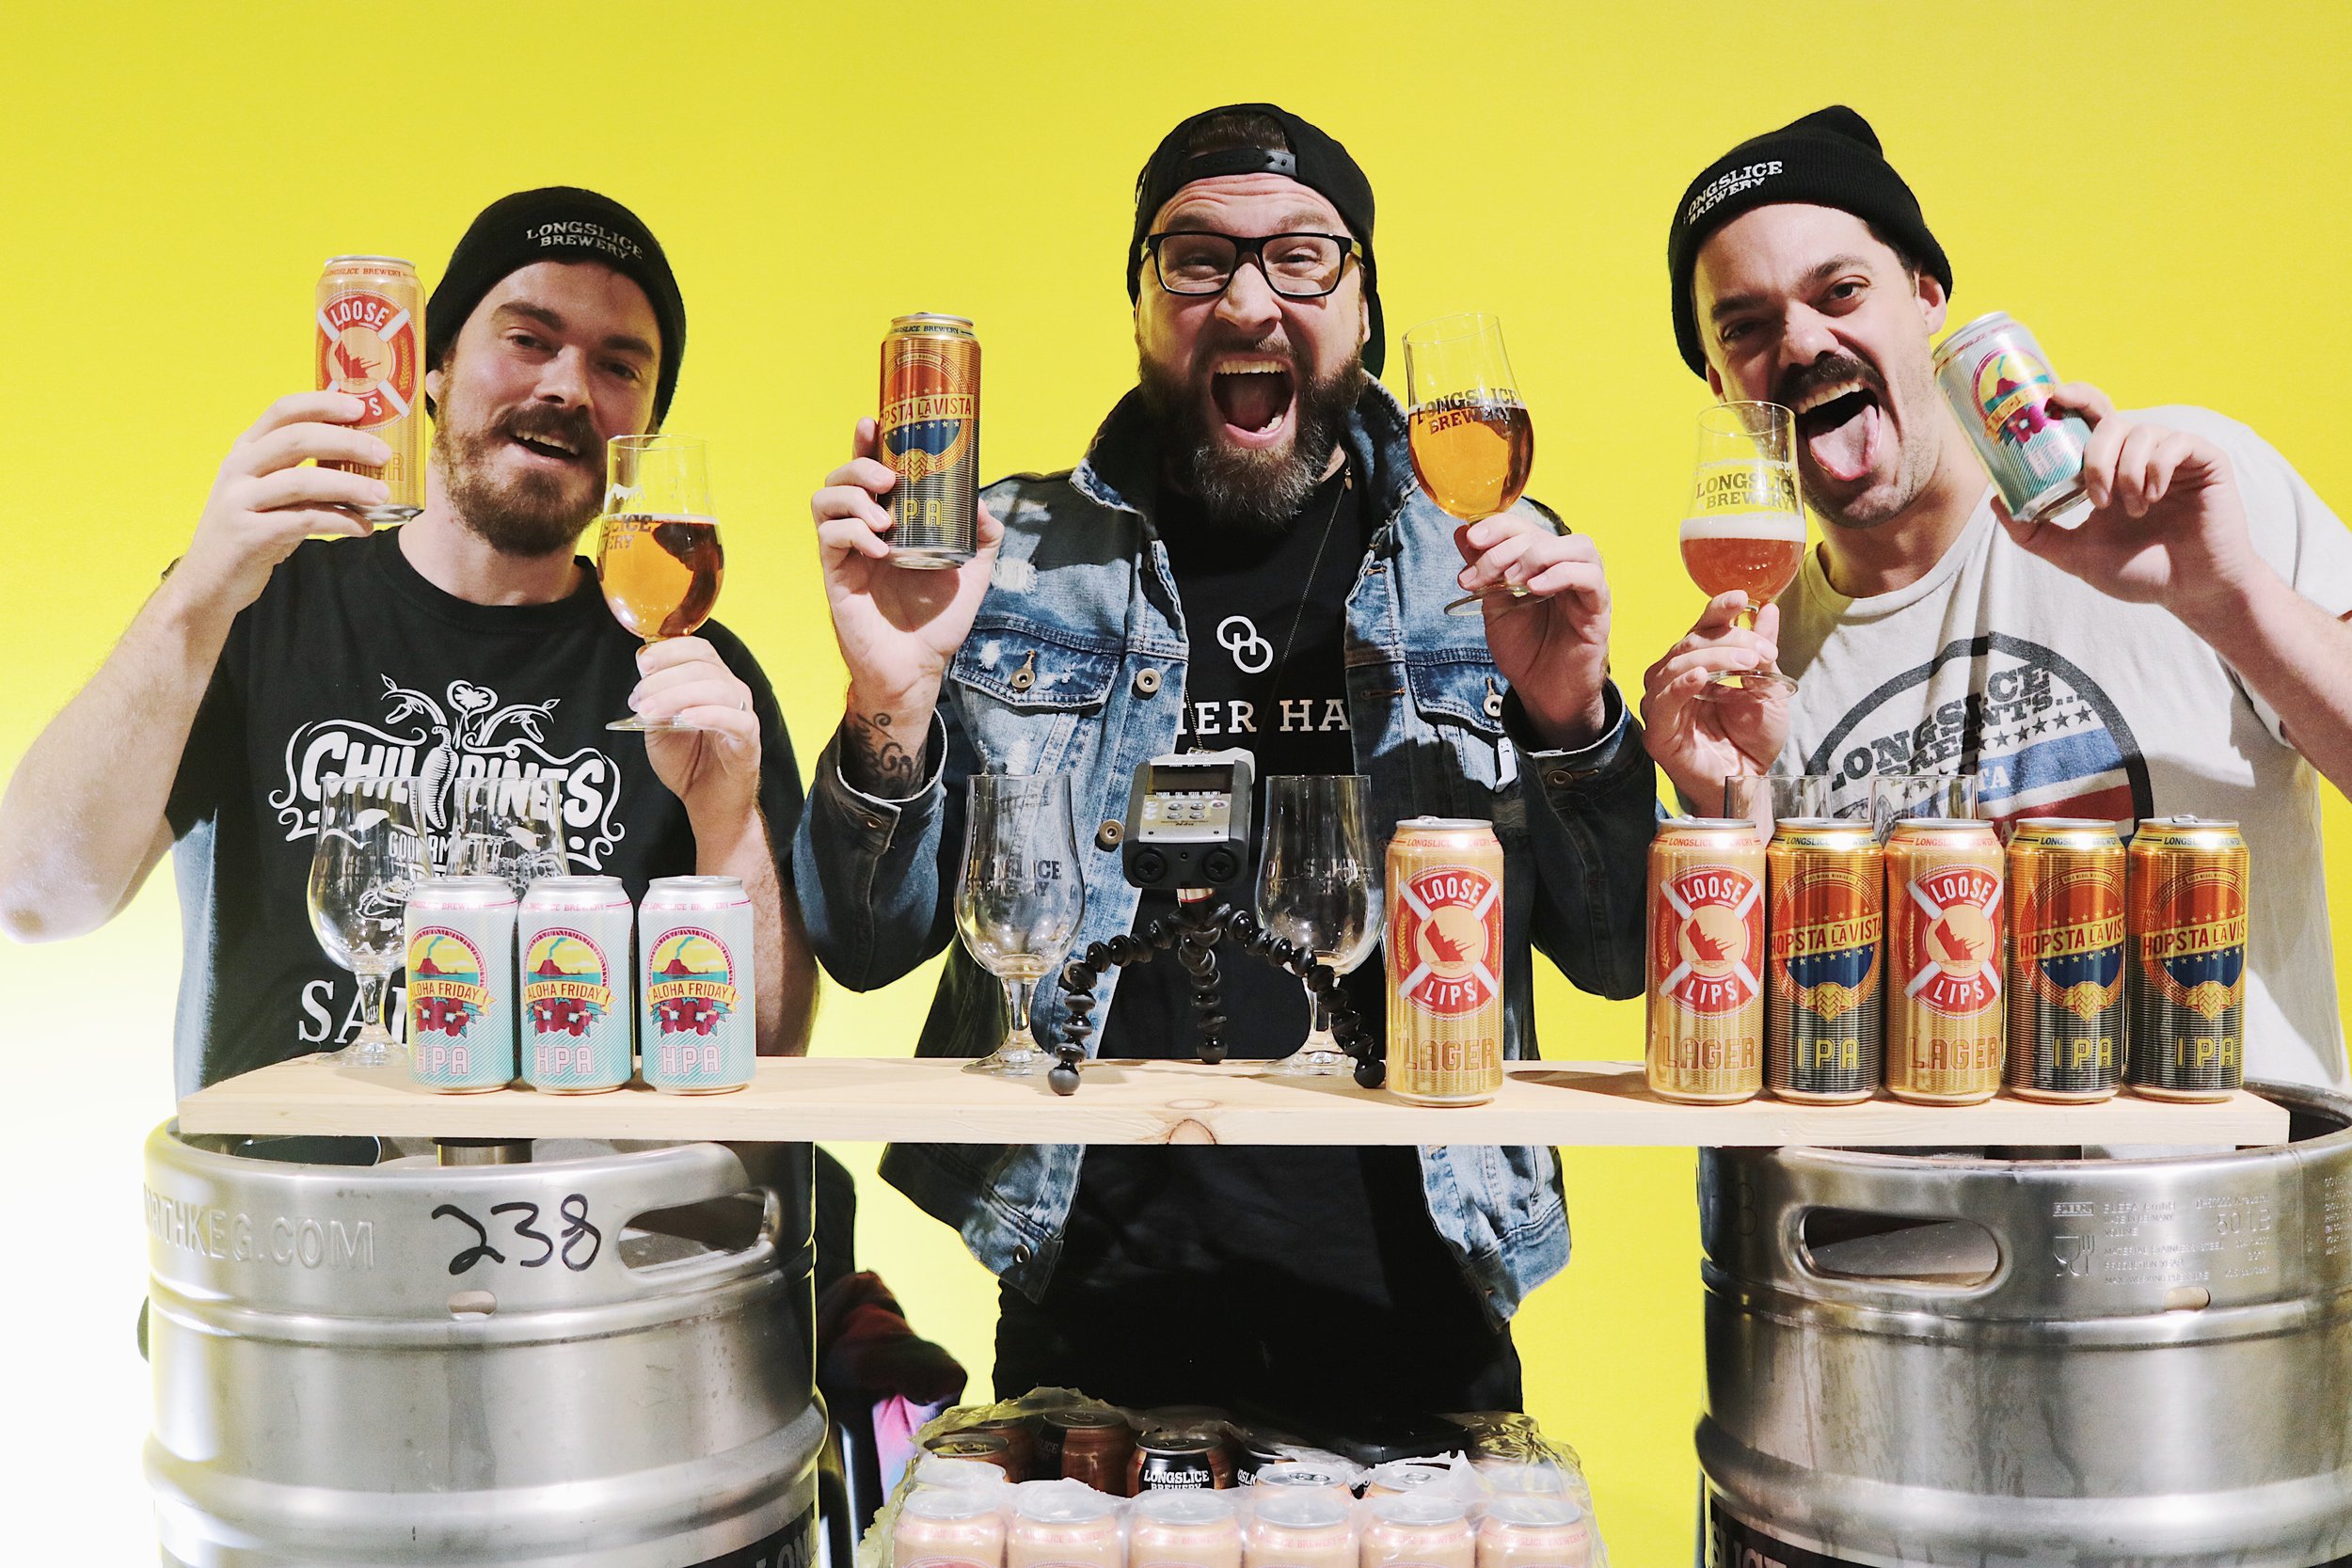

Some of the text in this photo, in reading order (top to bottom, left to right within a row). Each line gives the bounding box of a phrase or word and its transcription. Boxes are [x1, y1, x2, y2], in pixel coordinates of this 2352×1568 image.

[1689, 177, 1766, 226] BREWERY
[526, 221, 643, 260] LONGSLICE
[540, 234, 631, 261] BREWERY
[330, 300, 390, 326] LOOSE
[923, 325, 959, 335] BREWERY
[934, 398, 972, 416] VISTA
[1416, 388, 1518, 426] LONGSLICE
[1428, 406, 1512, 436] BREWERY
[1706, 491, 1790, 511] BREWERY
[1832, 667, 2050, 791] ONGSLCE
[1420, 877, 1484, 904] LOOSE
[1681, 877, 1745, 904] LOOSE
[1930, 876, 1992, 904] LOOSE
[2020, 928, 2086, 958] HOPSTA
[2143, 928, 2209, 957] HOPSTA
[438, 982, 480, 1001] FRIDAY
[528, 983, 602, 1000] ALOHA FRIDAY
[652, 982, 729, 1000] ALOHA FRIDAY
[1424, 980, 1478, 1006] LIPS
[1685, 980, 1739, 1005] LIPS
[1933, 979, 1985, 1005] LIPS
[416, 1045, 469, 1074] HPA
[535, 1045, 593, 1074] HPA
[661, 1045, 721, 1074] HPA
[1404, 1037, 1495, 1071] LAGER
[1662, 1037, 1756, 1069] LAGER
[1796, 1037, 1859, 1069] IPA
[1909, 1037, 1998, 1069] LAGER
[2054, 1036, 2113, 1069] IPA
[2175, 1036, 2235, 1069] IPA
[431, 1193, 602, 1275] 238
[1143, 1469, 1210, 1484] LONGSLICE
